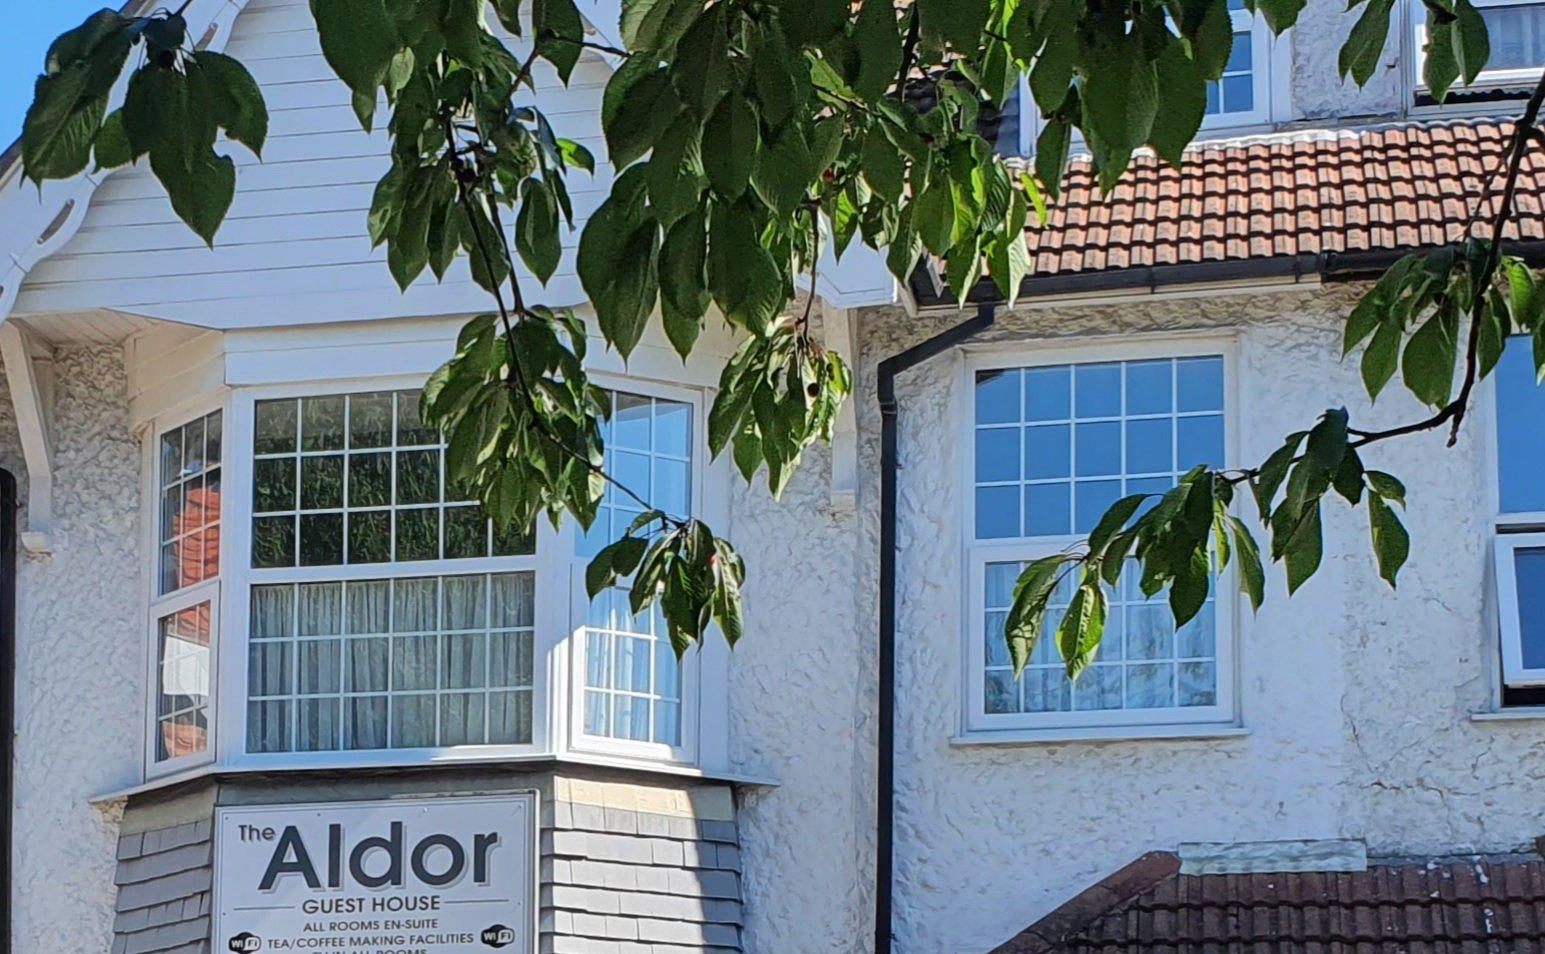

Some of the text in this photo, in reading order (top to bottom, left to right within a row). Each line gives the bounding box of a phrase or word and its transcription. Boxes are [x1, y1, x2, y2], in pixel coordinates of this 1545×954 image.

[238, 821, 500, 891] The Aldor
[302, 895, 441, 914] GUEST HOUSE
[303, 918, 439, 932] ALL ROOMS EN-SUITE
[268, 932, 474, 949] TEA/COFFEE MAKING FACILITIES
